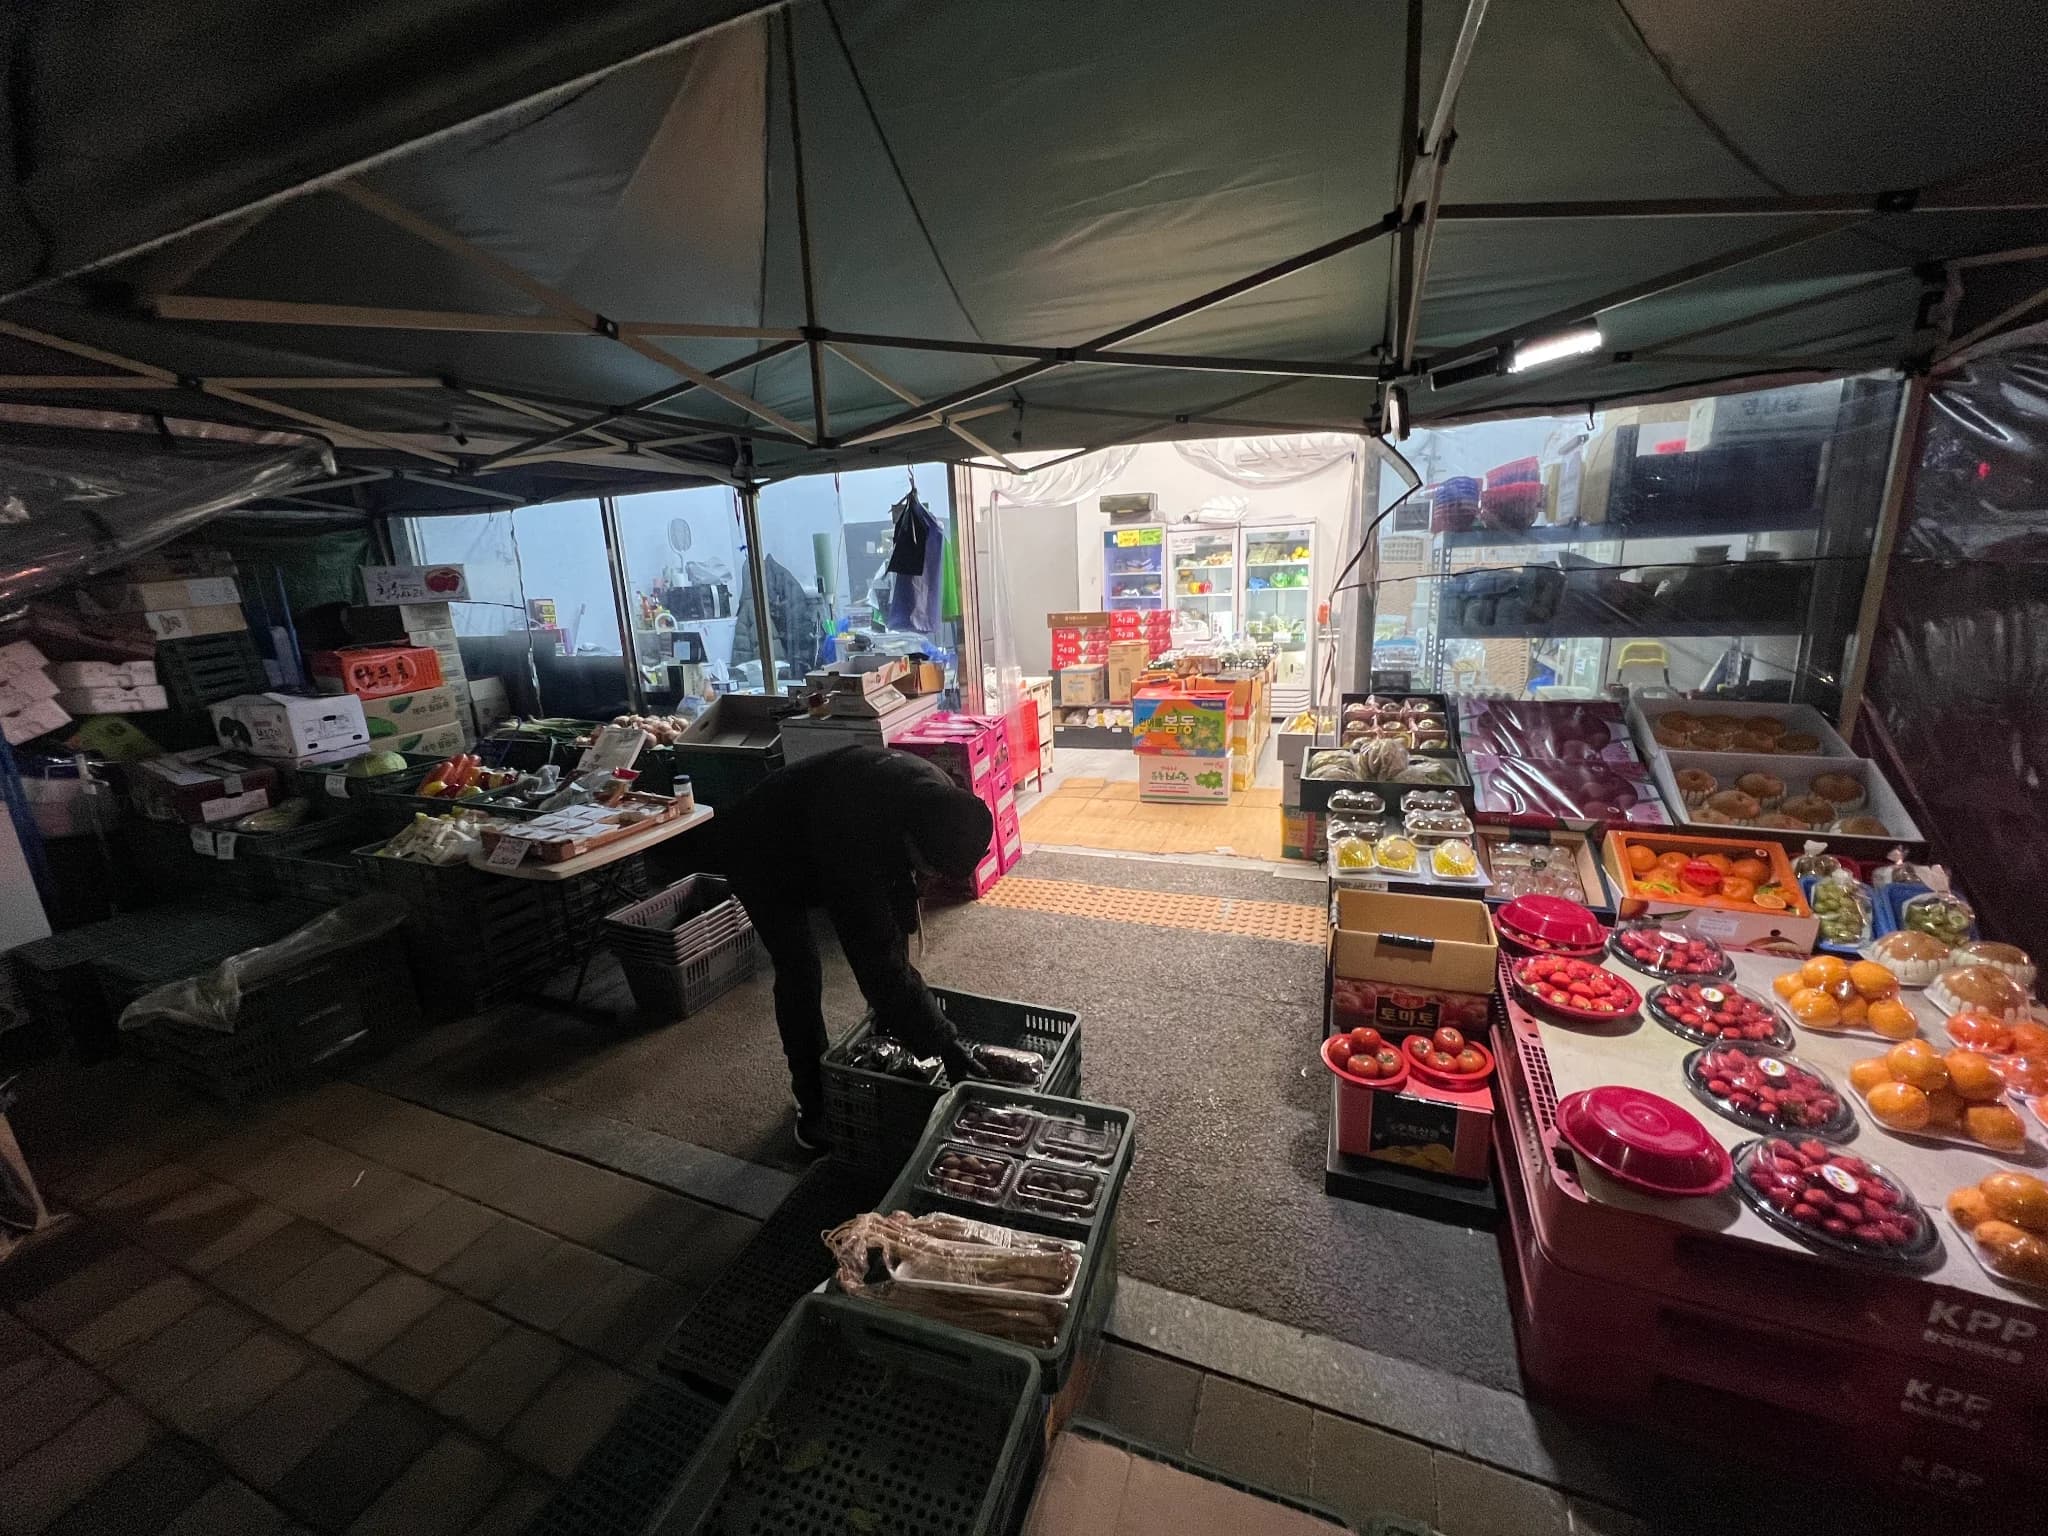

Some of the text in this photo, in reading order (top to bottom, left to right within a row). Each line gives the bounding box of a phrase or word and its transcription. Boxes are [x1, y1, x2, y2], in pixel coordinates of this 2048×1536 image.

[1162, 715, 1196, 736] 봄동
[1380, 1007, 1436, 1028] 토마토
[1928, 1299, 2037, 1344] KPP
